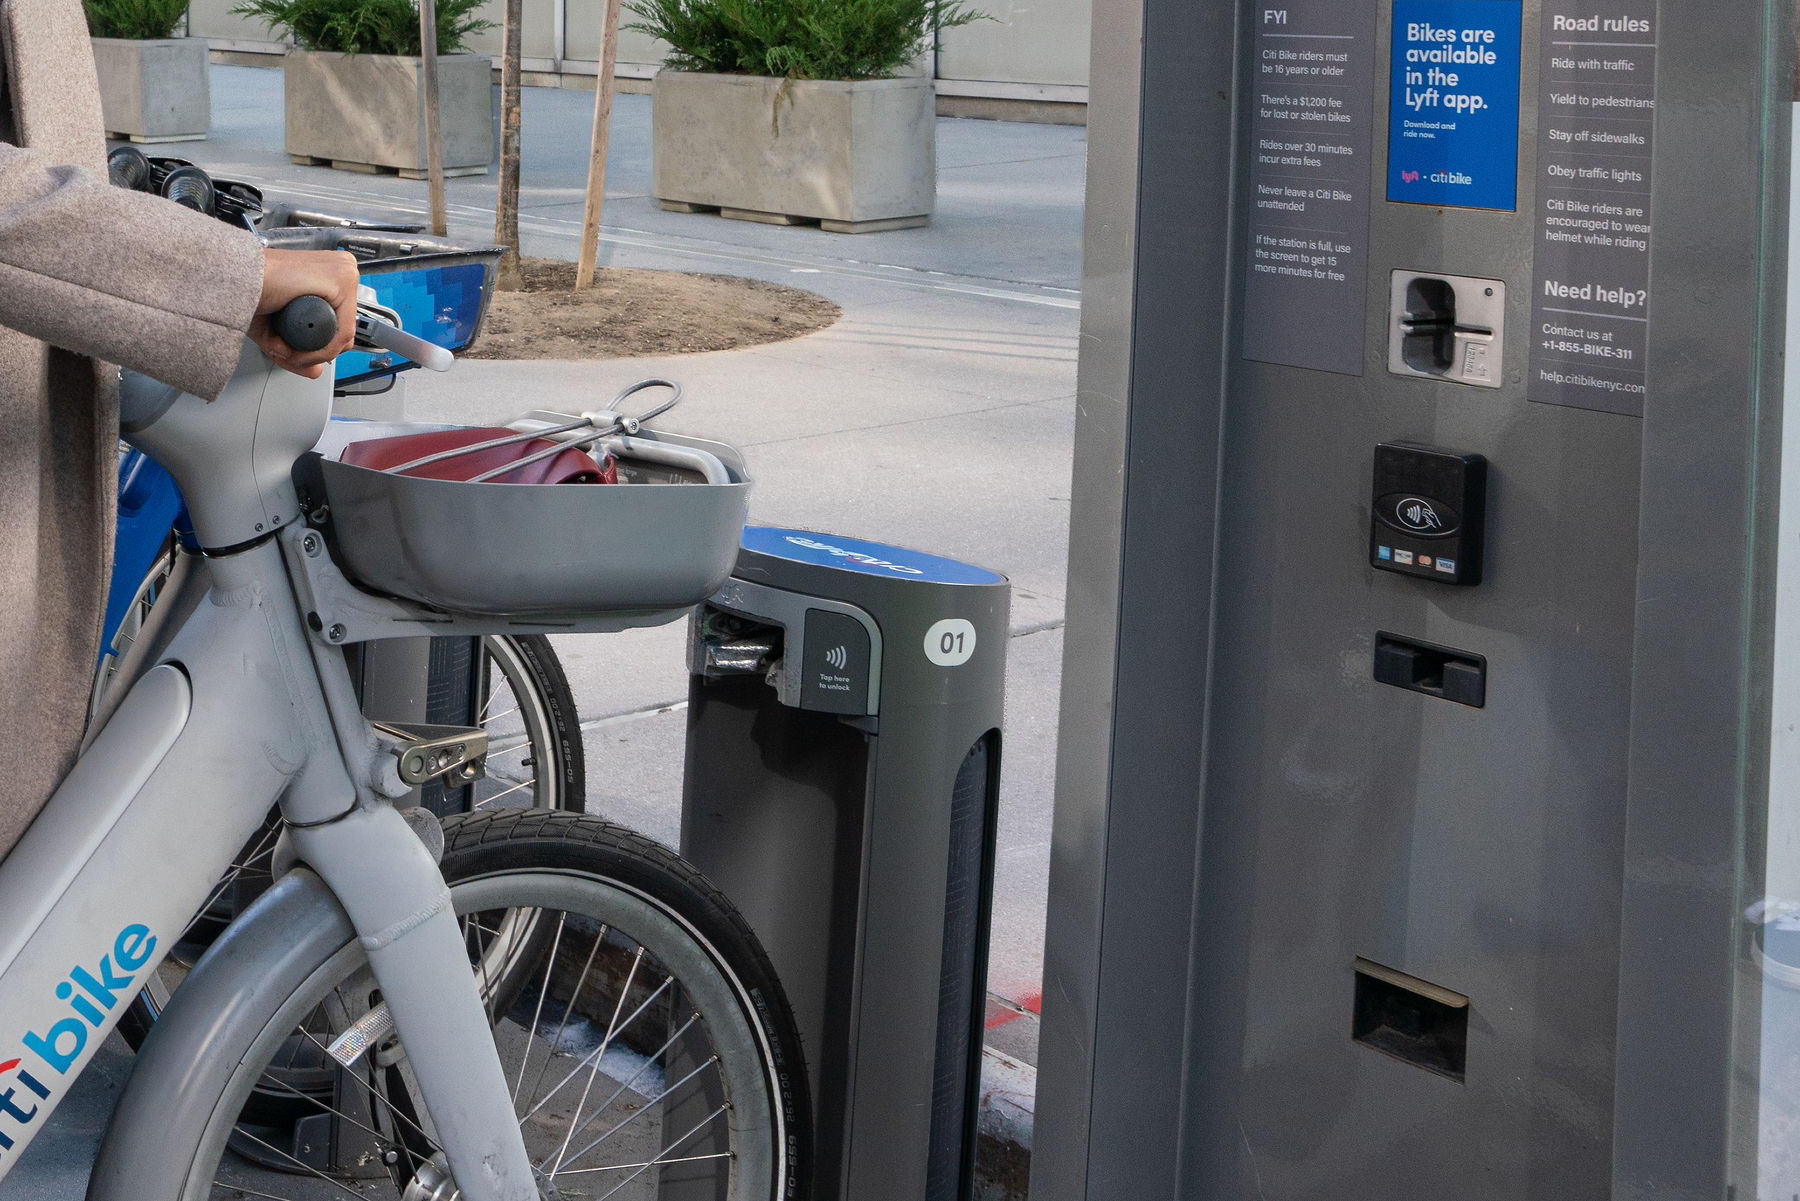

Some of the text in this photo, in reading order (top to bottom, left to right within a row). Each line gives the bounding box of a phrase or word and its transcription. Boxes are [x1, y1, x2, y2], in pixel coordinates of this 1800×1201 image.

[1264, 9, 1286, 24] FYI
[1553, 14, 1649, 32] Road rules
[1407, 22, 1495, 43] Bikes are
[1262, 49, 1347, 61] Citi Bike riders must
[1406, 44, 1496, 64] available
[1261, 63, 1273, 73] be
[1274, 64, 1283, 73] 16
[1285, 66, 1309, 76] years
[1321, 65, 1344, 75] older
[1551, 57, 1634, 70] Ride with traffic
[1406, 66, 1458, 86] in the
[1260, 94, 1291, 105] There's
[1292, 97, 1298, 105] a
[1328, 97, 1342, 107] fee
[1405, 87, 1488, 114] Lyft app.
[1549, 93, 1576, 104] Yield
[1578, 95, 1589, 105] to
[1260, 107, 1351, 122] for lost or stolen bikes
[1548, 128, 1644, 144] Stay off sidewalks
[1259, 139, 1352, 155] Rides over 30 minutes
[1259, 152, 1321, 166] incur extra fees
[1431, 170, 1448, 183] citi
[1449, 173, 1472, 185] bike
[1547, 164, 1641, 182] Obey traffic lights
[1258, 184, 1352, 201] Never leave a Citi Bike
[1257, 199, 1304, 211] unattended
[1546, 199, 1643, 216] Citi Bike riders are
[1545, 216, 1608, 231] encouraged
[1610, 220, 1622, 231] to
[1545, 229, 1646, 251] helmet while riding
[1544, 280, 1646, 308] Need help?
[1542, 323, 1612, 341] Contact us at
[1541, 340, 1632, 359] +1-855-BIKE-311
[940, 632, 965, 654] 01
[22, 923, 157, 1075] bike
